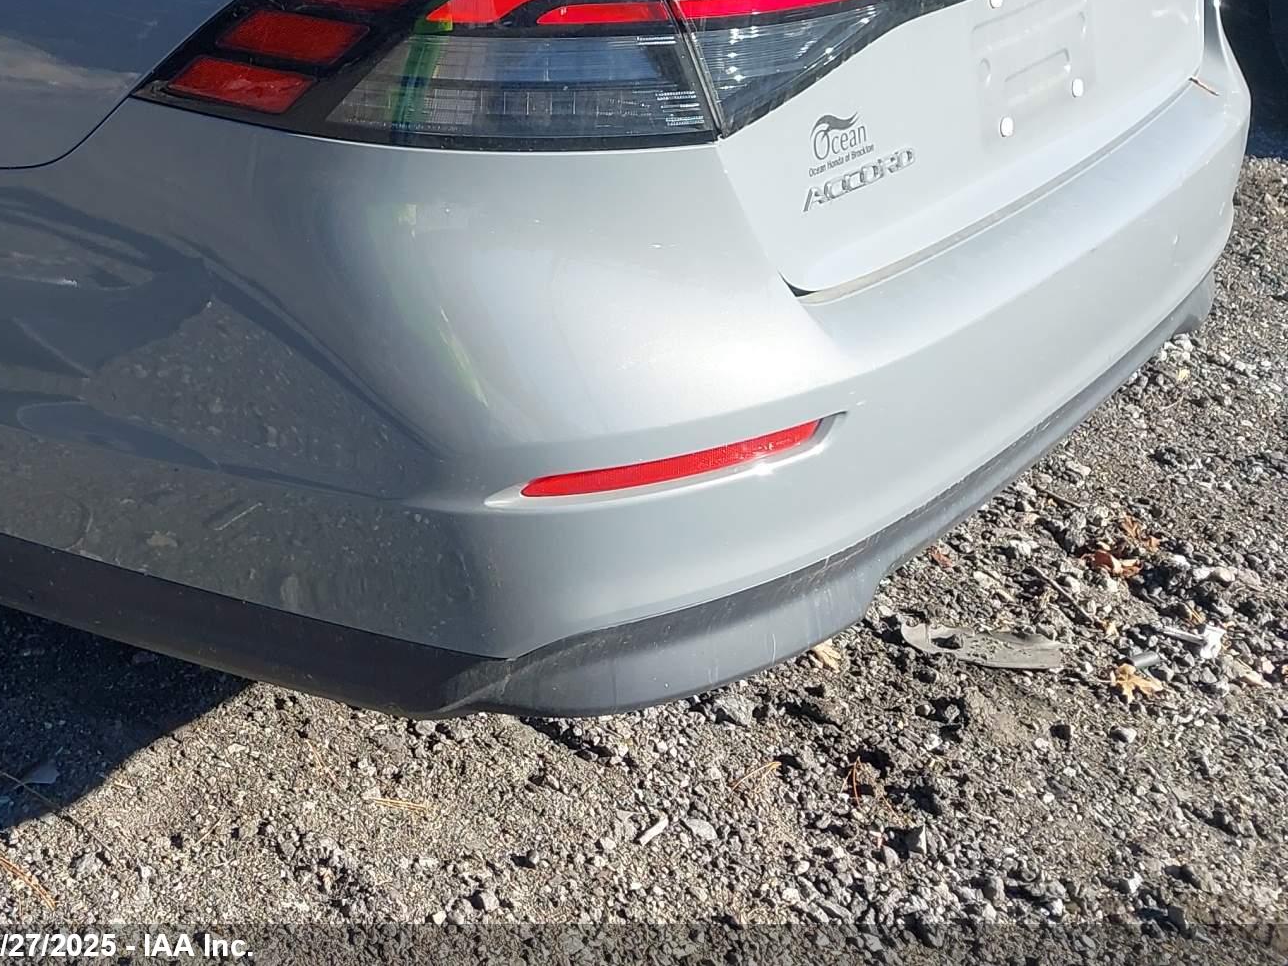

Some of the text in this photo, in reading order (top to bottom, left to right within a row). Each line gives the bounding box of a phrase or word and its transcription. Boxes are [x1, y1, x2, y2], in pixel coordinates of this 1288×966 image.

[813, 125, 867, 161] Ocean
[803, 148, 916, 213] ACCORD
[808, 163, 827, 177] Ocean
